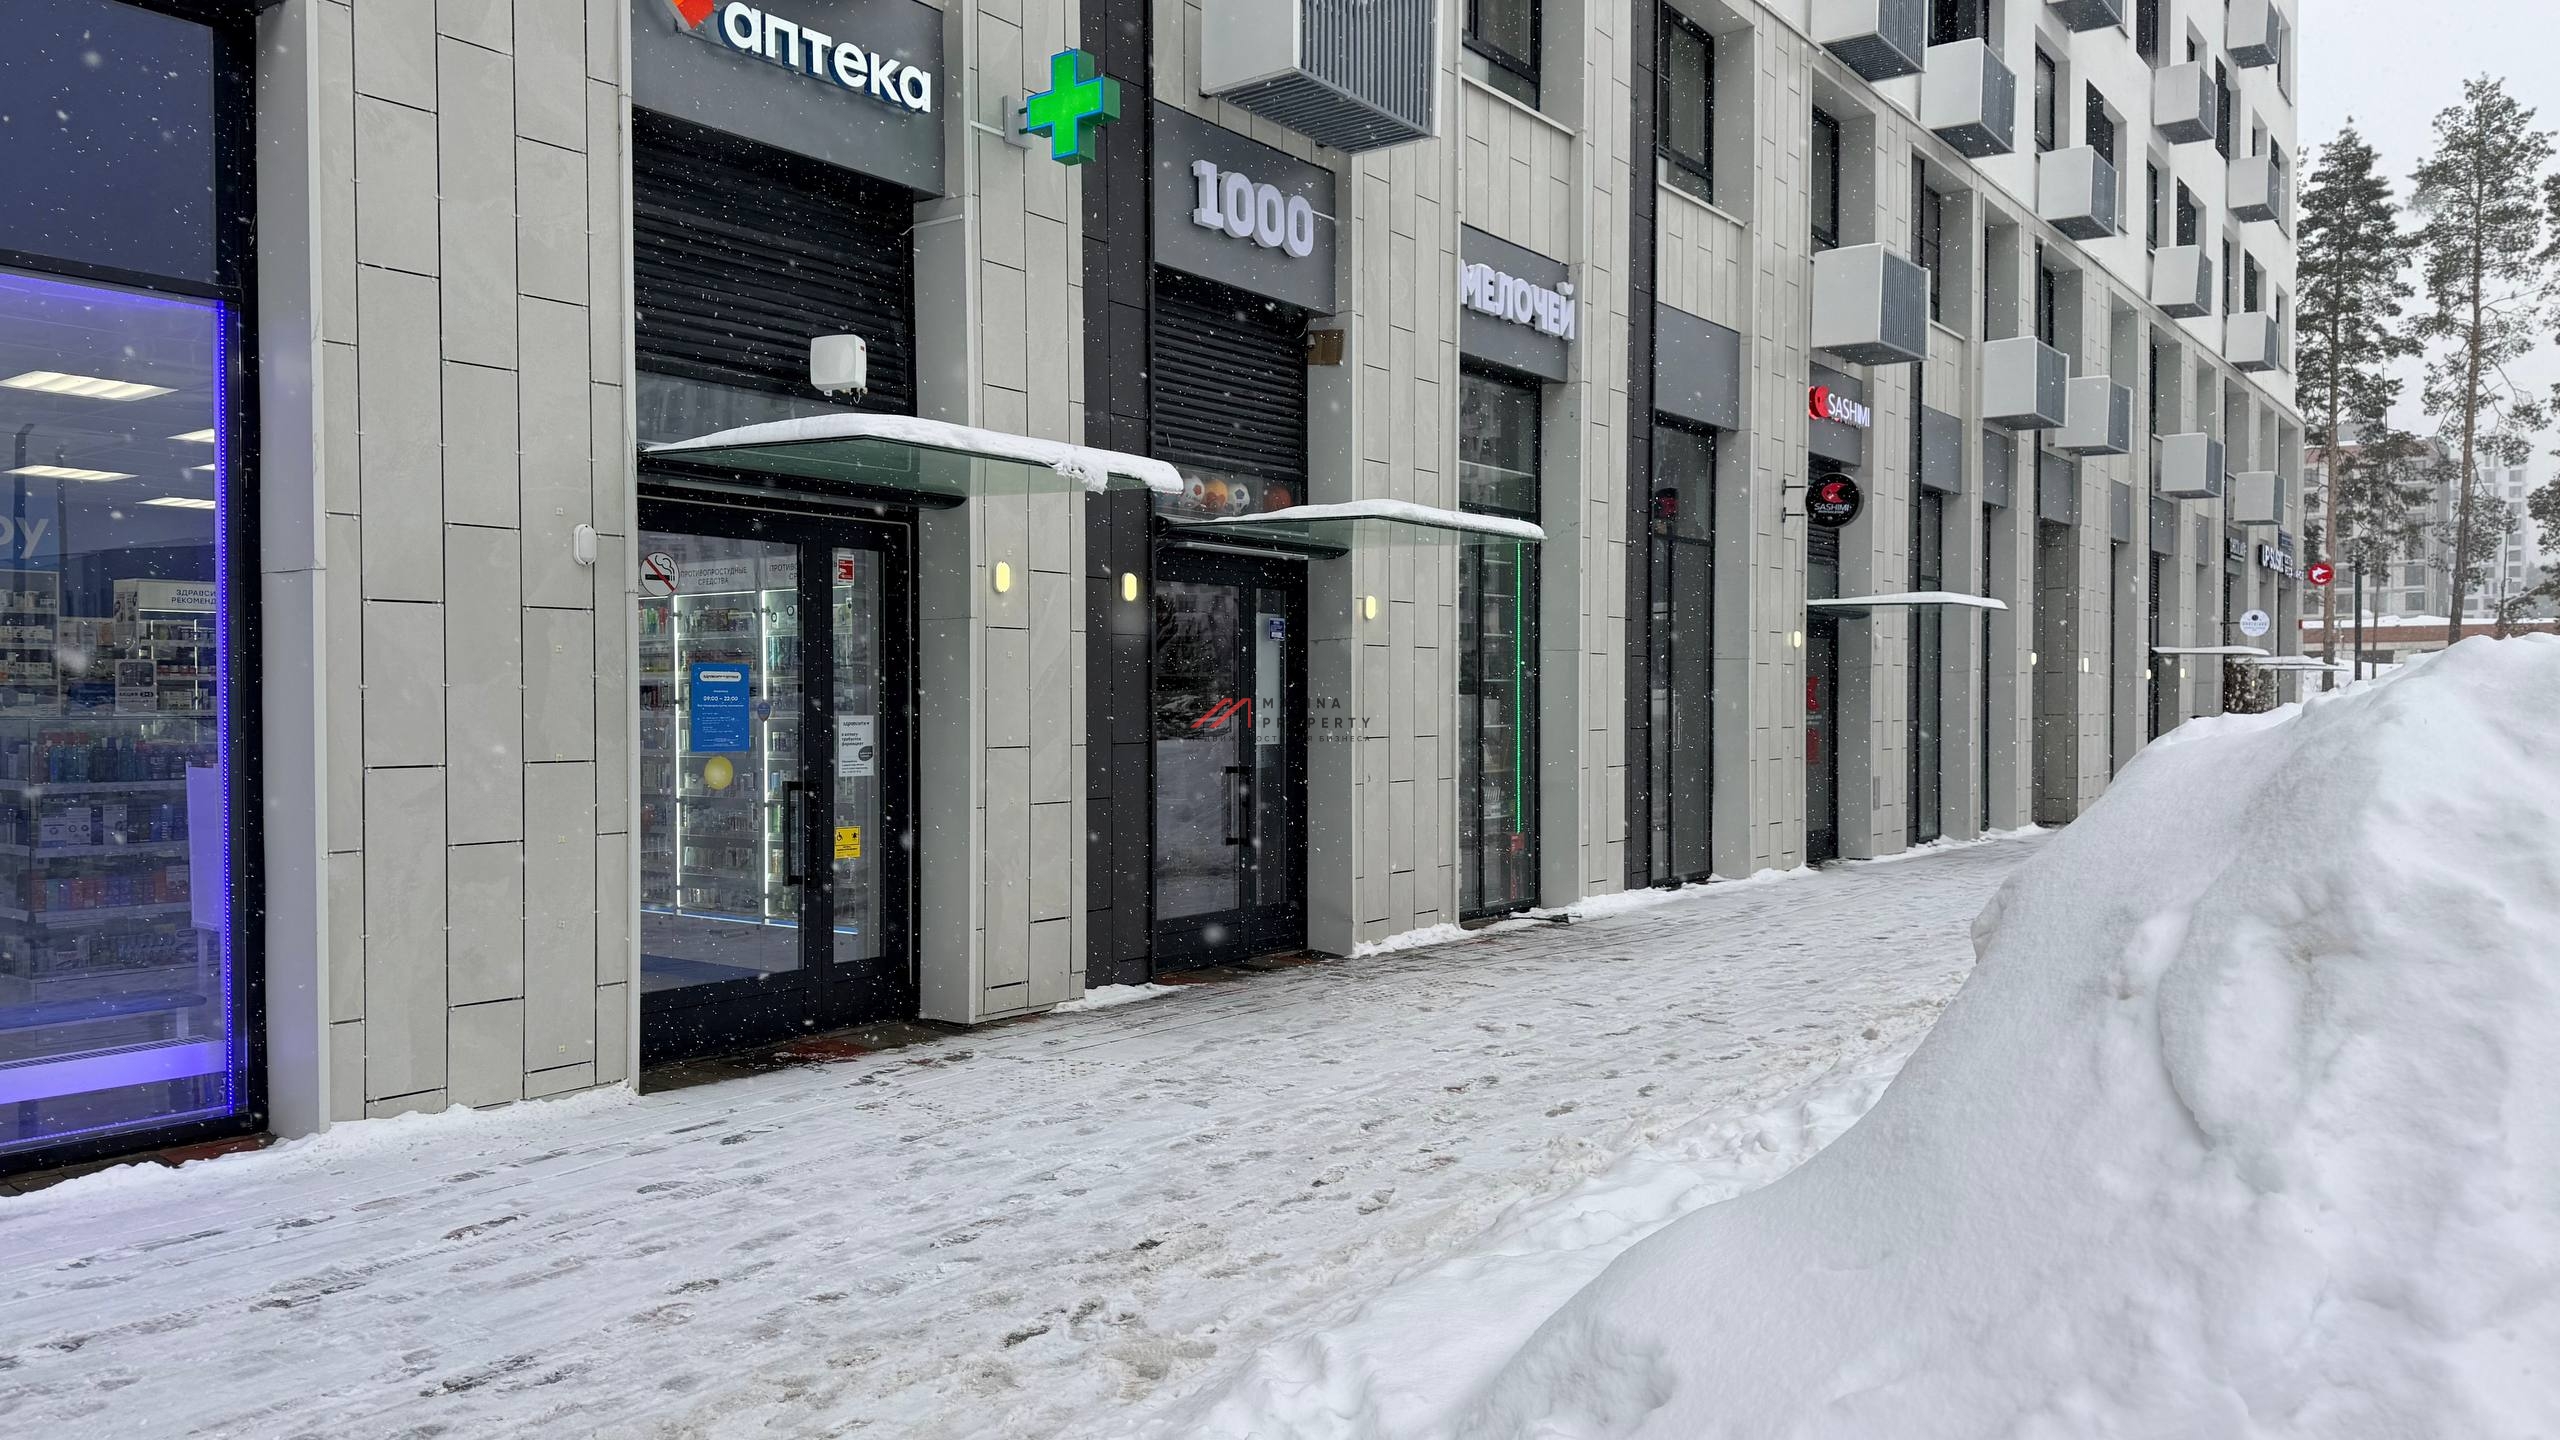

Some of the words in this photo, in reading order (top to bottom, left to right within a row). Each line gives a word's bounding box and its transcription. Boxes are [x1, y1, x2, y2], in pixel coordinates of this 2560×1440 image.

[719, 1, 932, 113] аптека
[1191, 160, 1314, 257] 1000
[1460, 259, 1575, 340] МЕЛОЧЕЙ
[1828, 393, 1870, 427] SASHIMI
[1814, 503, 1849, 512] SASHIMI
[680, 566, 748, 577] ПРОТИВОПРОСТУДНЫЕ
[697, 577, 729, 586] СРЕДСТВА
